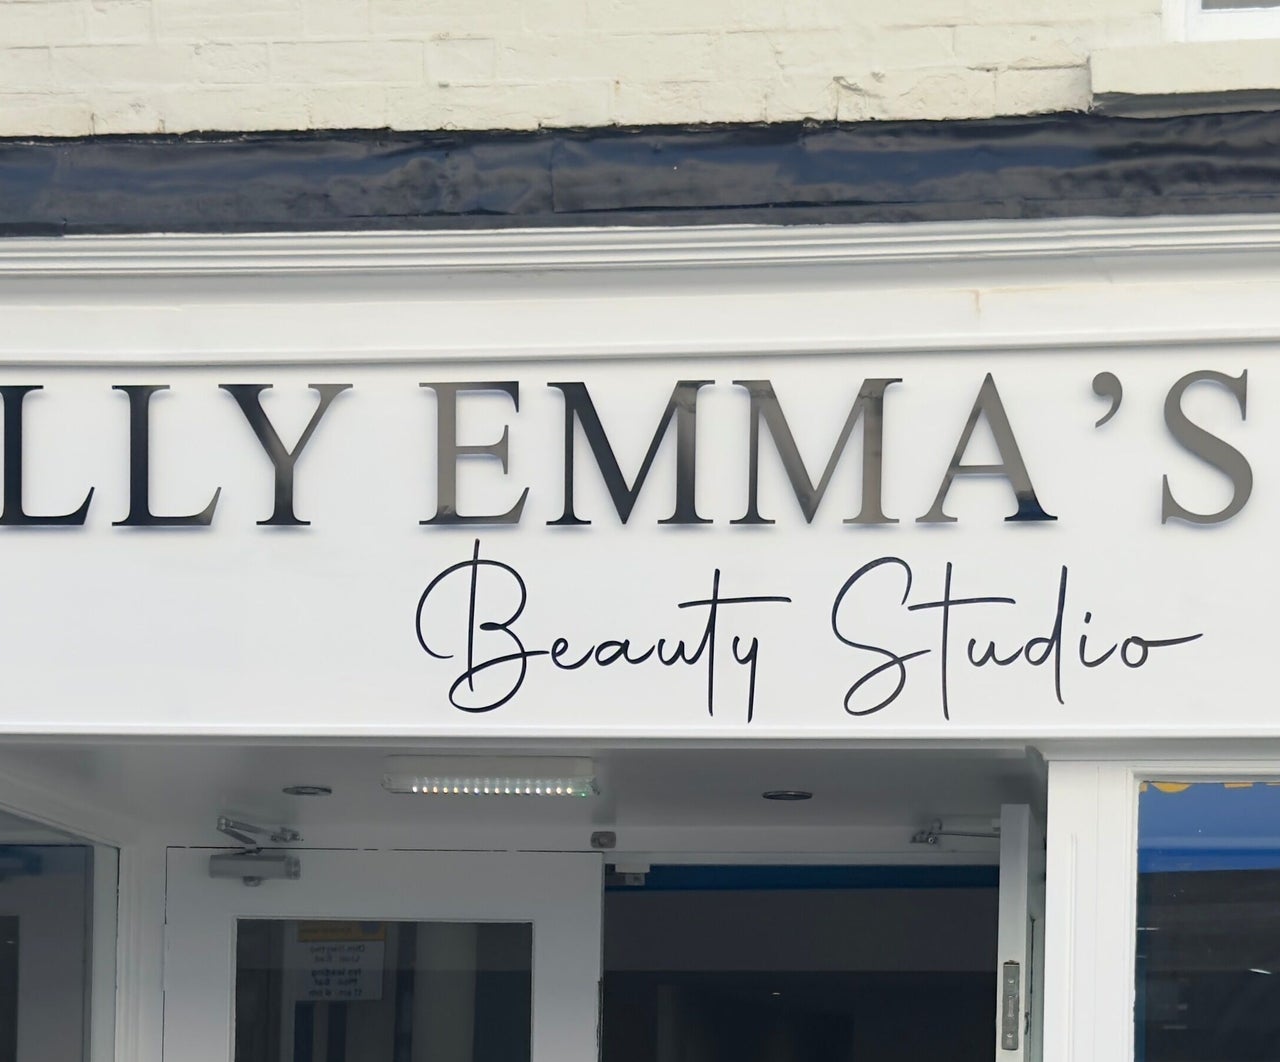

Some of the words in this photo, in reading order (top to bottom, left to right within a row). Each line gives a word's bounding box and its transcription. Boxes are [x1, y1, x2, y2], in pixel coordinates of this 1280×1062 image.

[418, 368, 1254, 527] EMMA'S
[415, 538, 792, 723] Beauty
[831, 556, 1204, 721] Studio
